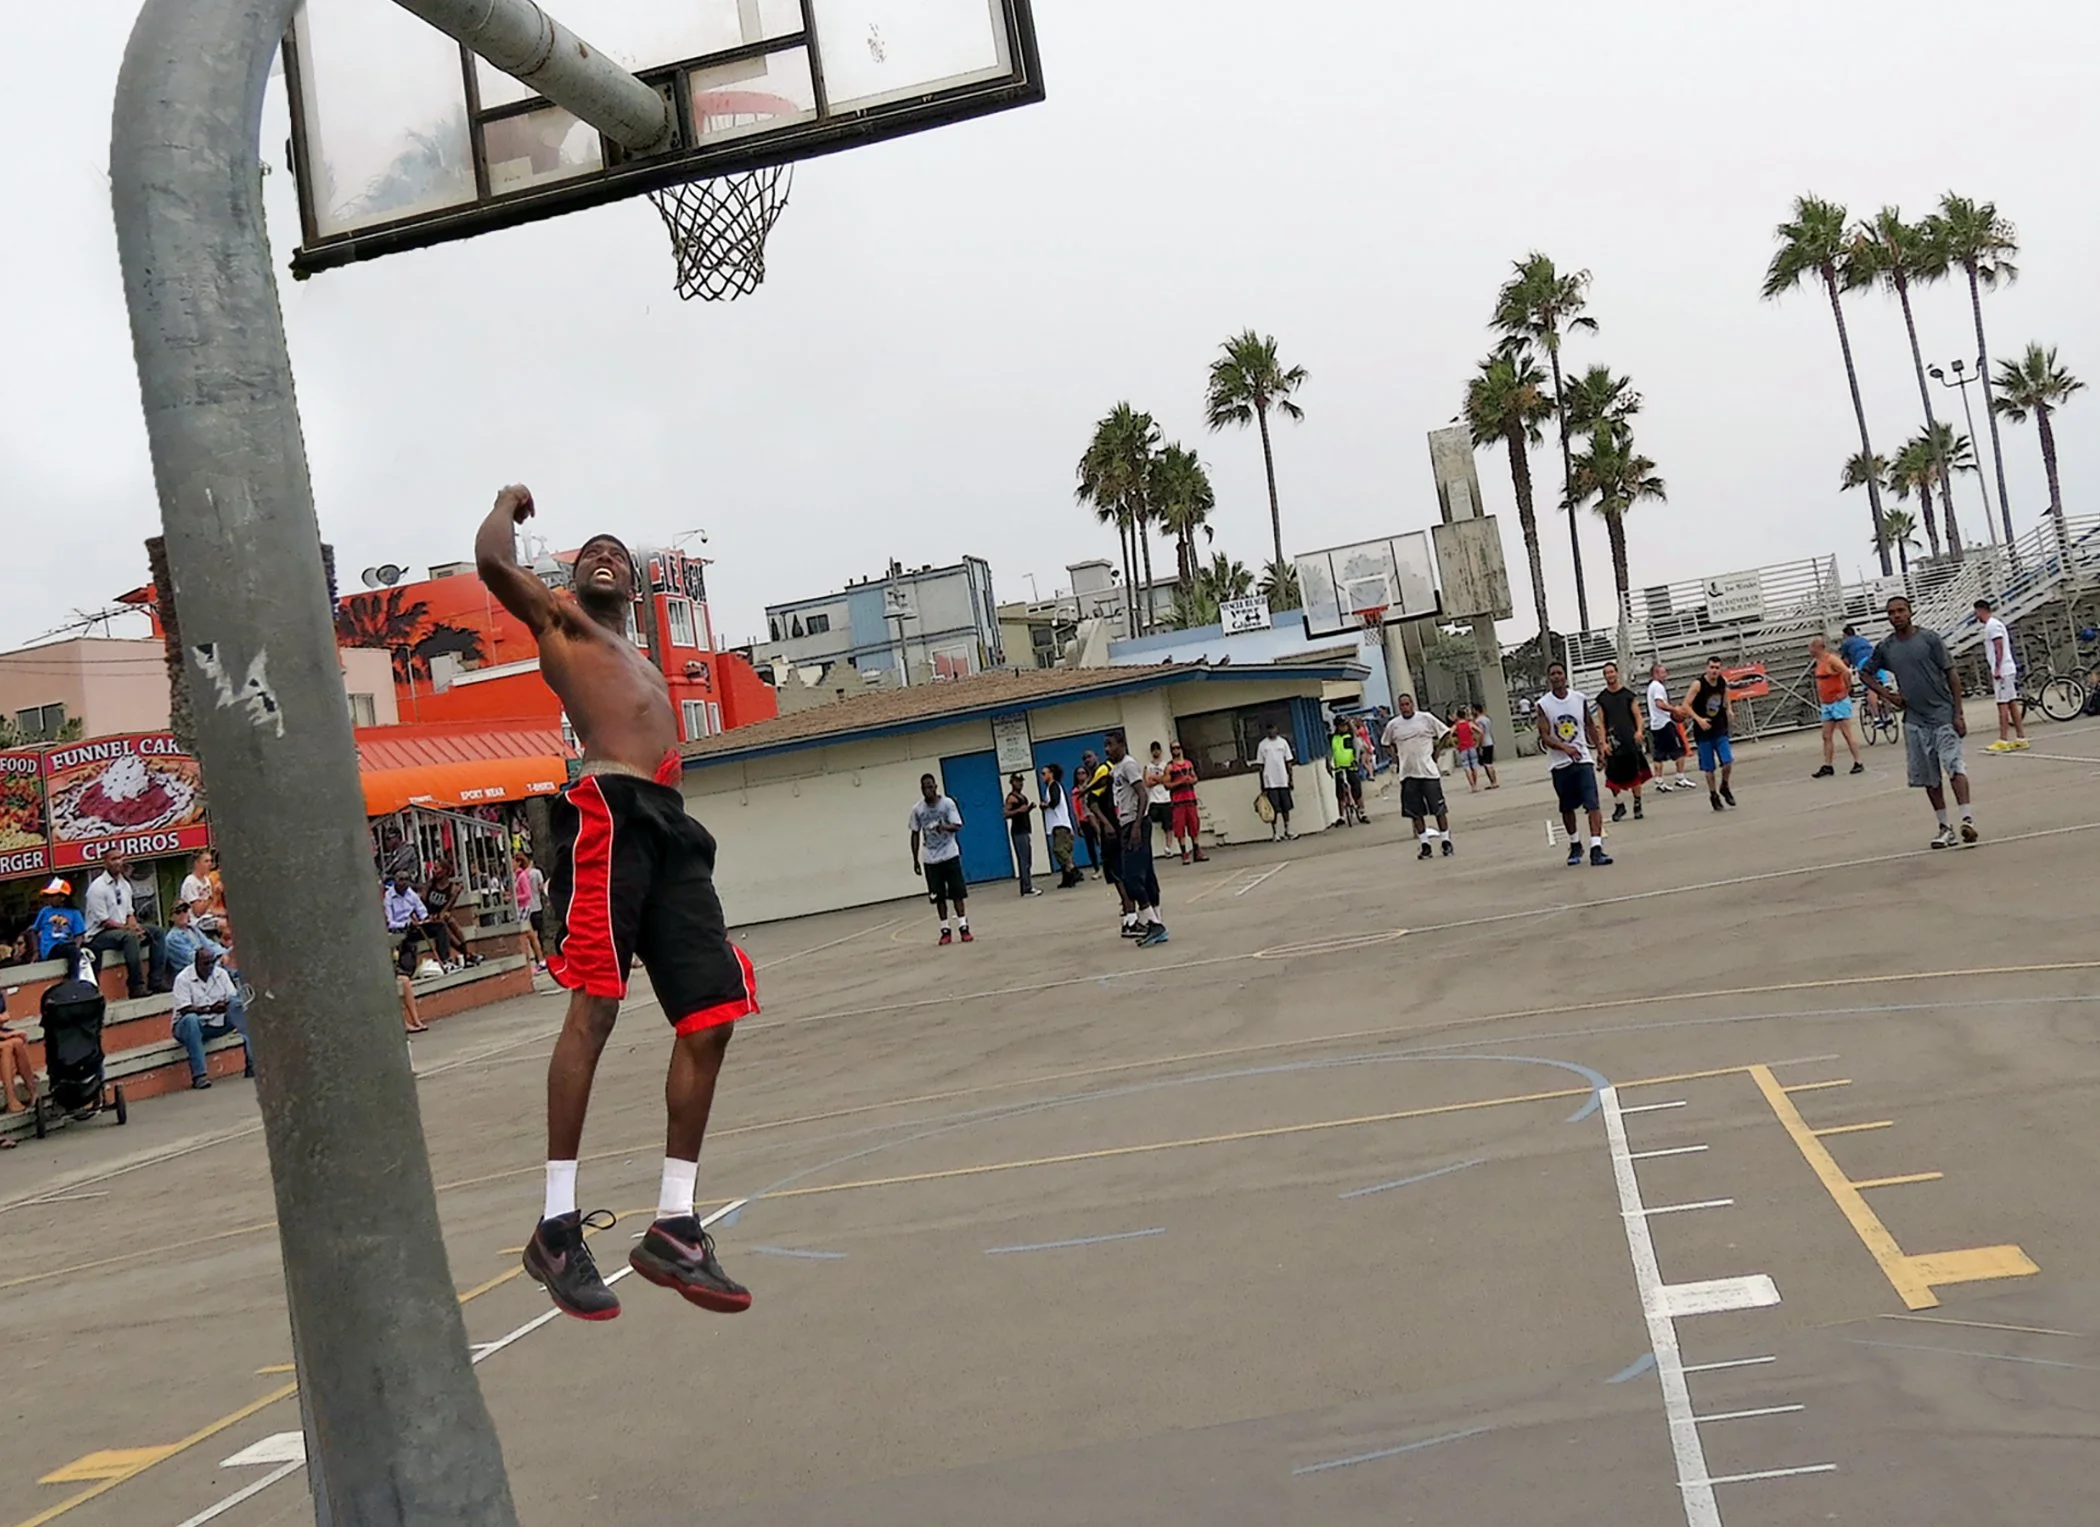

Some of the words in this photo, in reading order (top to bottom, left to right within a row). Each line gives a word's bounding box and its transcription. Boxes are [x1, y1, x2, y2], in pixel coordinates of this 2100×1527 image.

[0, 757, 37, 773] FOOD
[51, 740, 136, 770] FUNNEL
[139, 738, 191, 755] CAK
[82, 832, 180, 860] CHURROS
